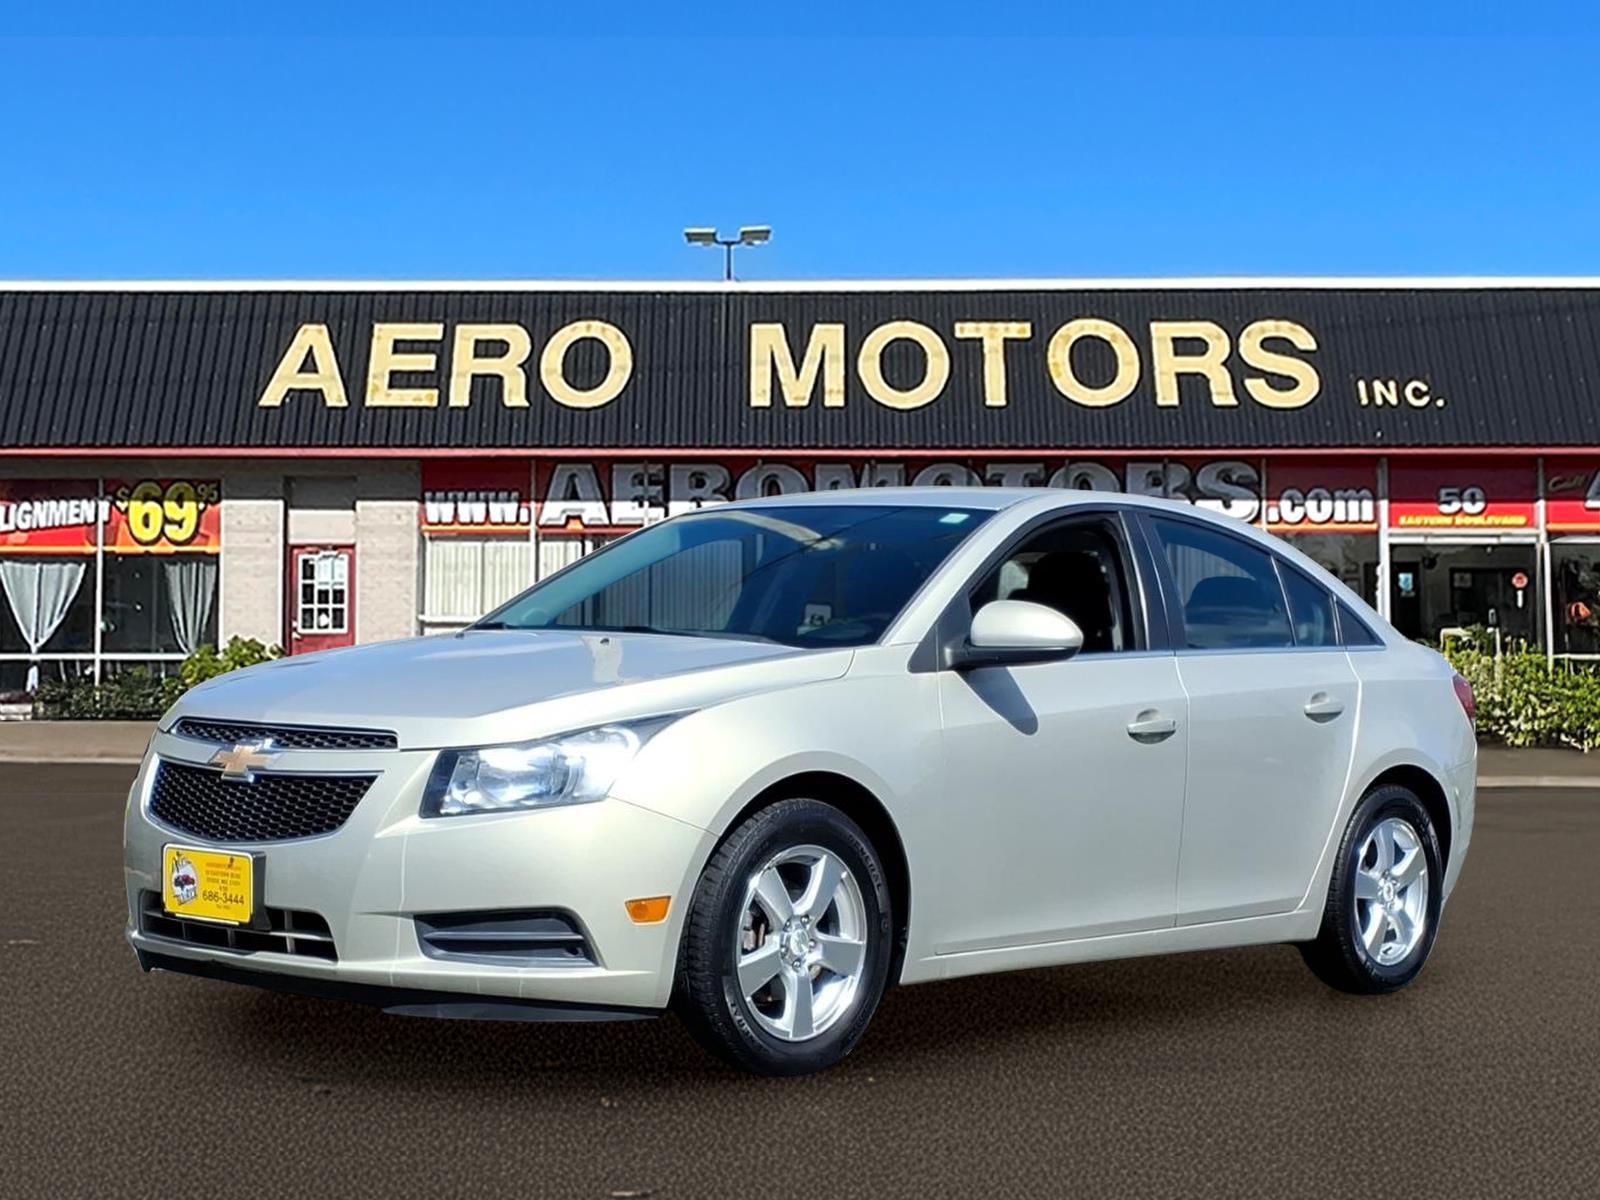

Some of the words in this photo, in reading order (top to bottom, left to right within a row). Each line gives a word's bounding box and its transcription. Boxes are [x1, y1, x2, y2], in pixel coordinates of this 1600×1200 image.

[258, 319, 633, 409] AERO
[750, 318, 1320, 410] MOTORS
[1357, 378, 1447, 408] INC.
[424, 490, 529, 525] www.
[1267, 486, 1375, 524] .com
[1438, 487, 1486, 514] 50
